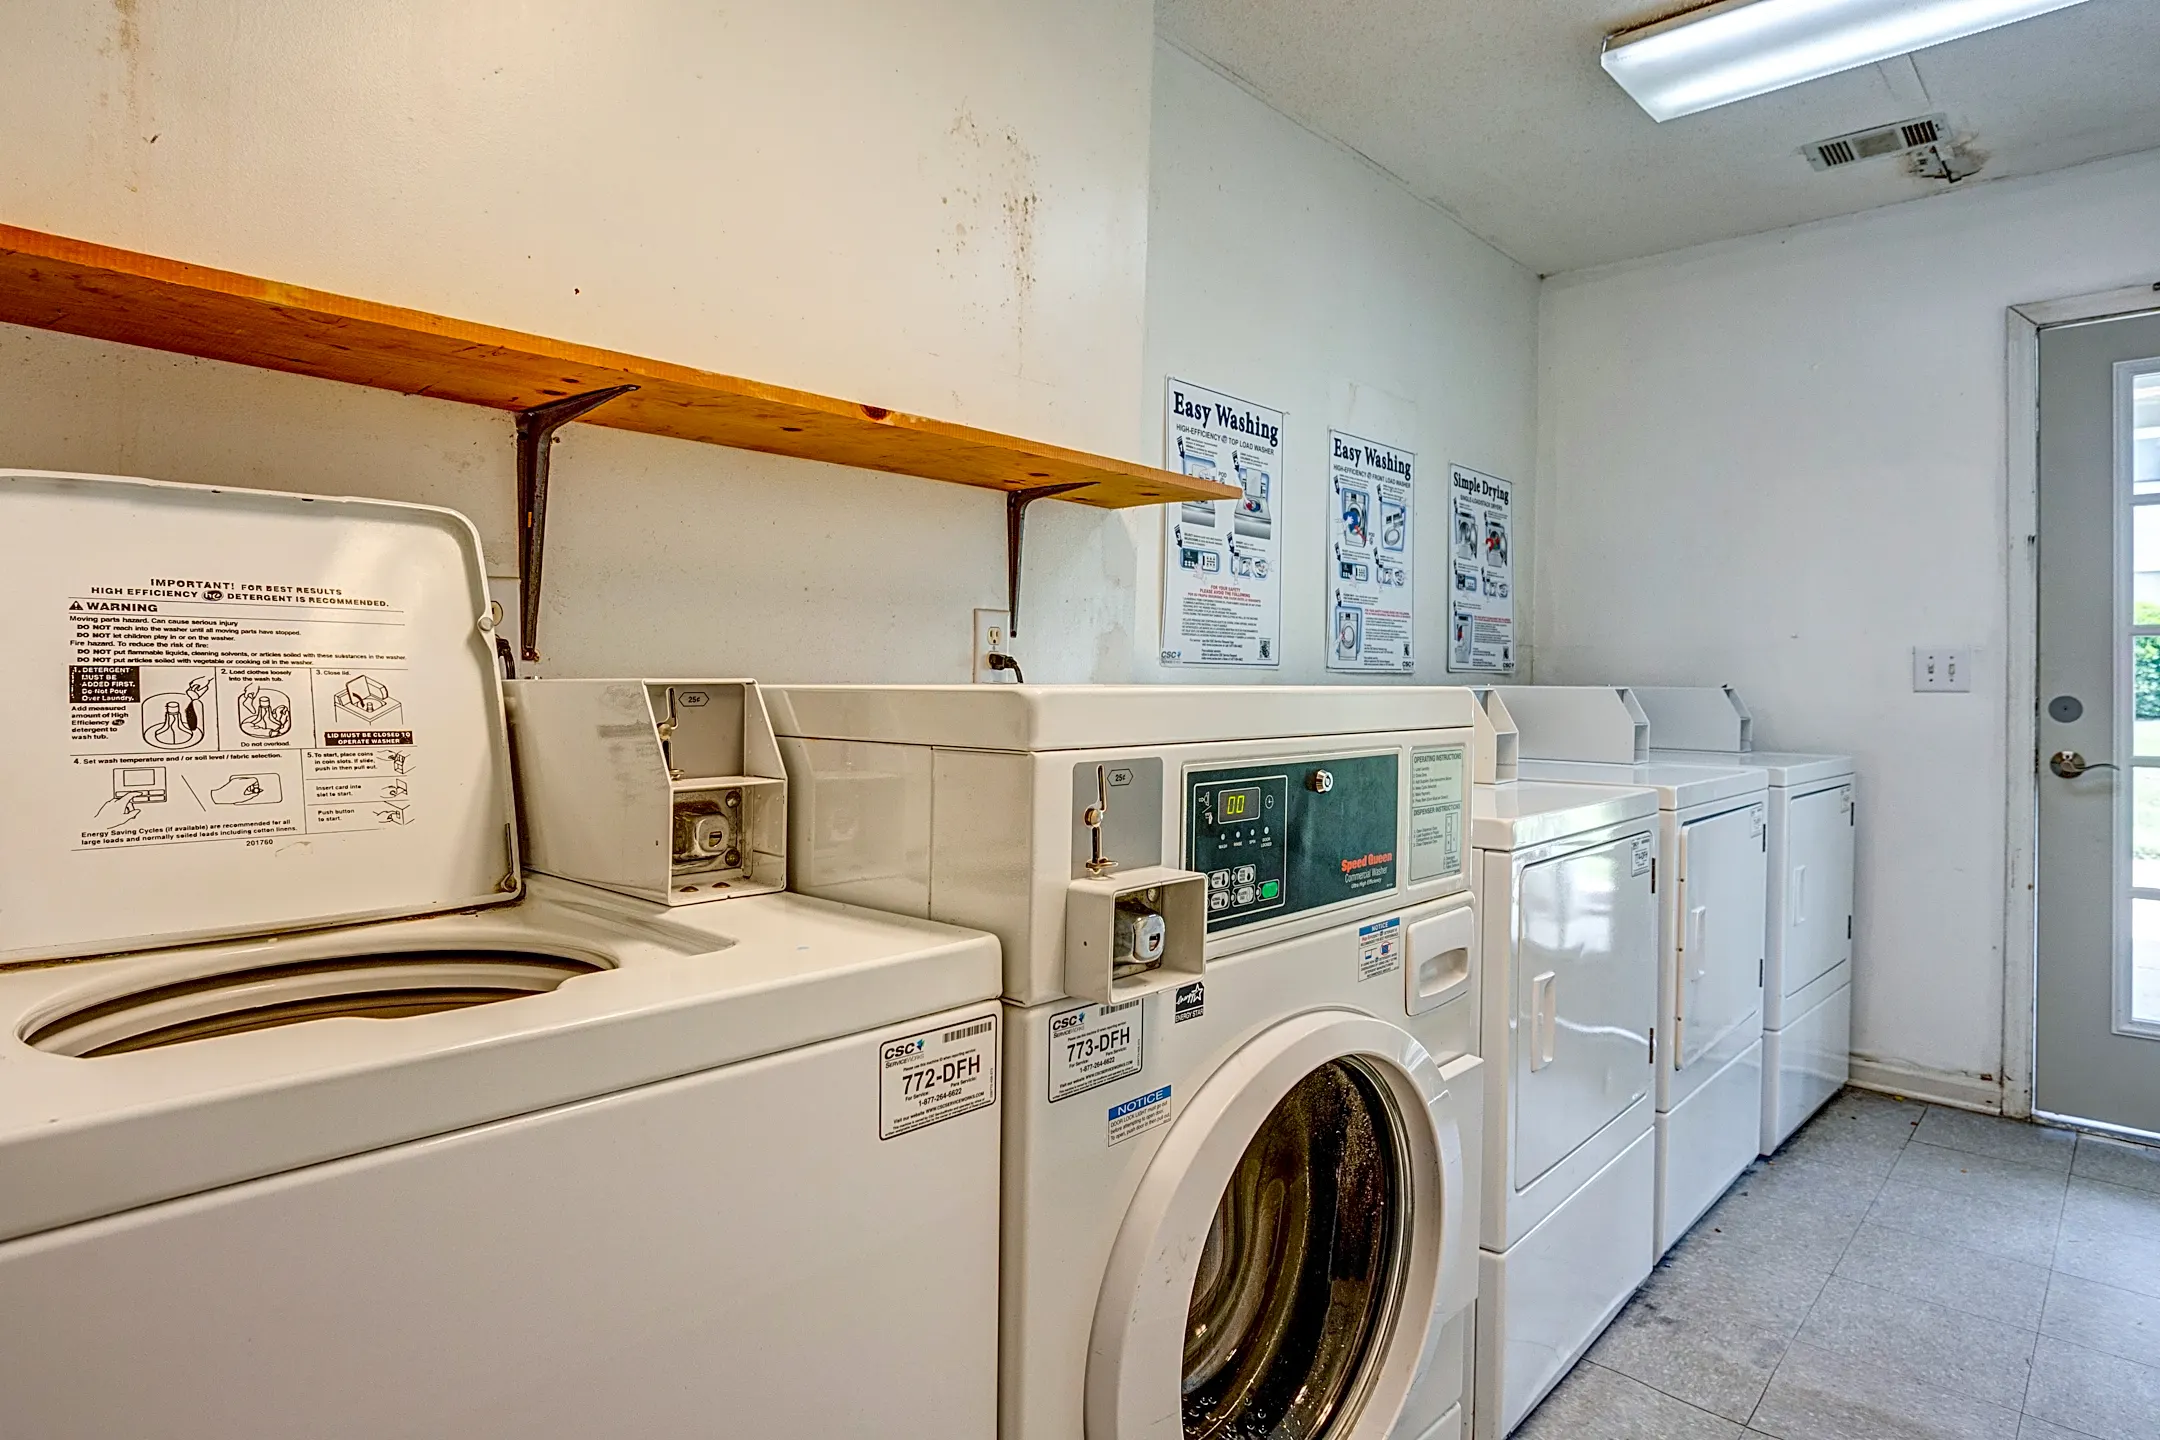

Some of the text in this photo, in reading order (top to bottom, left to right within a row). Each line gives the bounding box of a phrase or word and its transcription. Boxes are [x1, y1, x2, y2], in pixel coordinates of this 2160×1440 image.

[1174, 391, 1211, 428] Easy
[1215, 403, 1278, 447] Washing
[1176, 424, 1274, 455] HIGH-EFFICIENCY TOP LOAD WASHER
[1334, 437, 1411, 481] Easy Washing
[1454, 472, 1480, 495] Simple
[1482, 480, 1508, 505] Drying
[150, 579, 342, 596] IMPORTANT! FOR BEST RESULTS
[91, 587, 123, 595] HIGH
[127, 588, 198, 598] EFFICIENCY
[227, 593, 292, 602] DETERGENT
[308, 597, 389, 607] RECOMMENDED.
[87, 602, 158, 612] WARNING
[100, 616, 120, 624] parts
[122, 617, 149, 625] hazard.
[168, 618, 190, 626] cause
[1161, 651, 1176, 659] CSC
[111, 712, 129, 720] High
[1414, 753, 1461, 763] OPERATING INSTRUCTIONS
[1227, 795, 1245, 814] 00
[1413, 804, 1460, 816] DISPENSER INSTRUCTIONS
[246, 839, 273, 847] 201760
[1342, 853, 1392, 873] Speed Queen
[1345, 866, 1387, 883] Commercial Washer
[1371, 922, 1388, 931] NOTICE
[1053, 1015, 1077, 1030] CSC
[1175, 1008, 1203, 1022] ENERGY STAR
[885, 1042, 915, 1059] CSC
[1067, 1027, 1129, 1062] 773-DFH
[902, 1054, 980, 1095] 772-DFH
[1118, 1090, 1164, 1115] NOTICE
[1111, 1118, 1123, 1128] DOOR
[1124, 1113, 1134, 1123] LOCK
[1135, 1109, 1147, 1119] LIGHT
[1147, 1105, 1156, 1113] must
[1111, 1127, 1122, 1135] before
[1123, 1118, 1141, 1130] attempting
[1146, 1112, 1155, 1121] open
[1127, 1126, 1136, 1135] push
[1136, 1122, 1144, 1130] door
[1149, 1116, 1157, 1125] then
